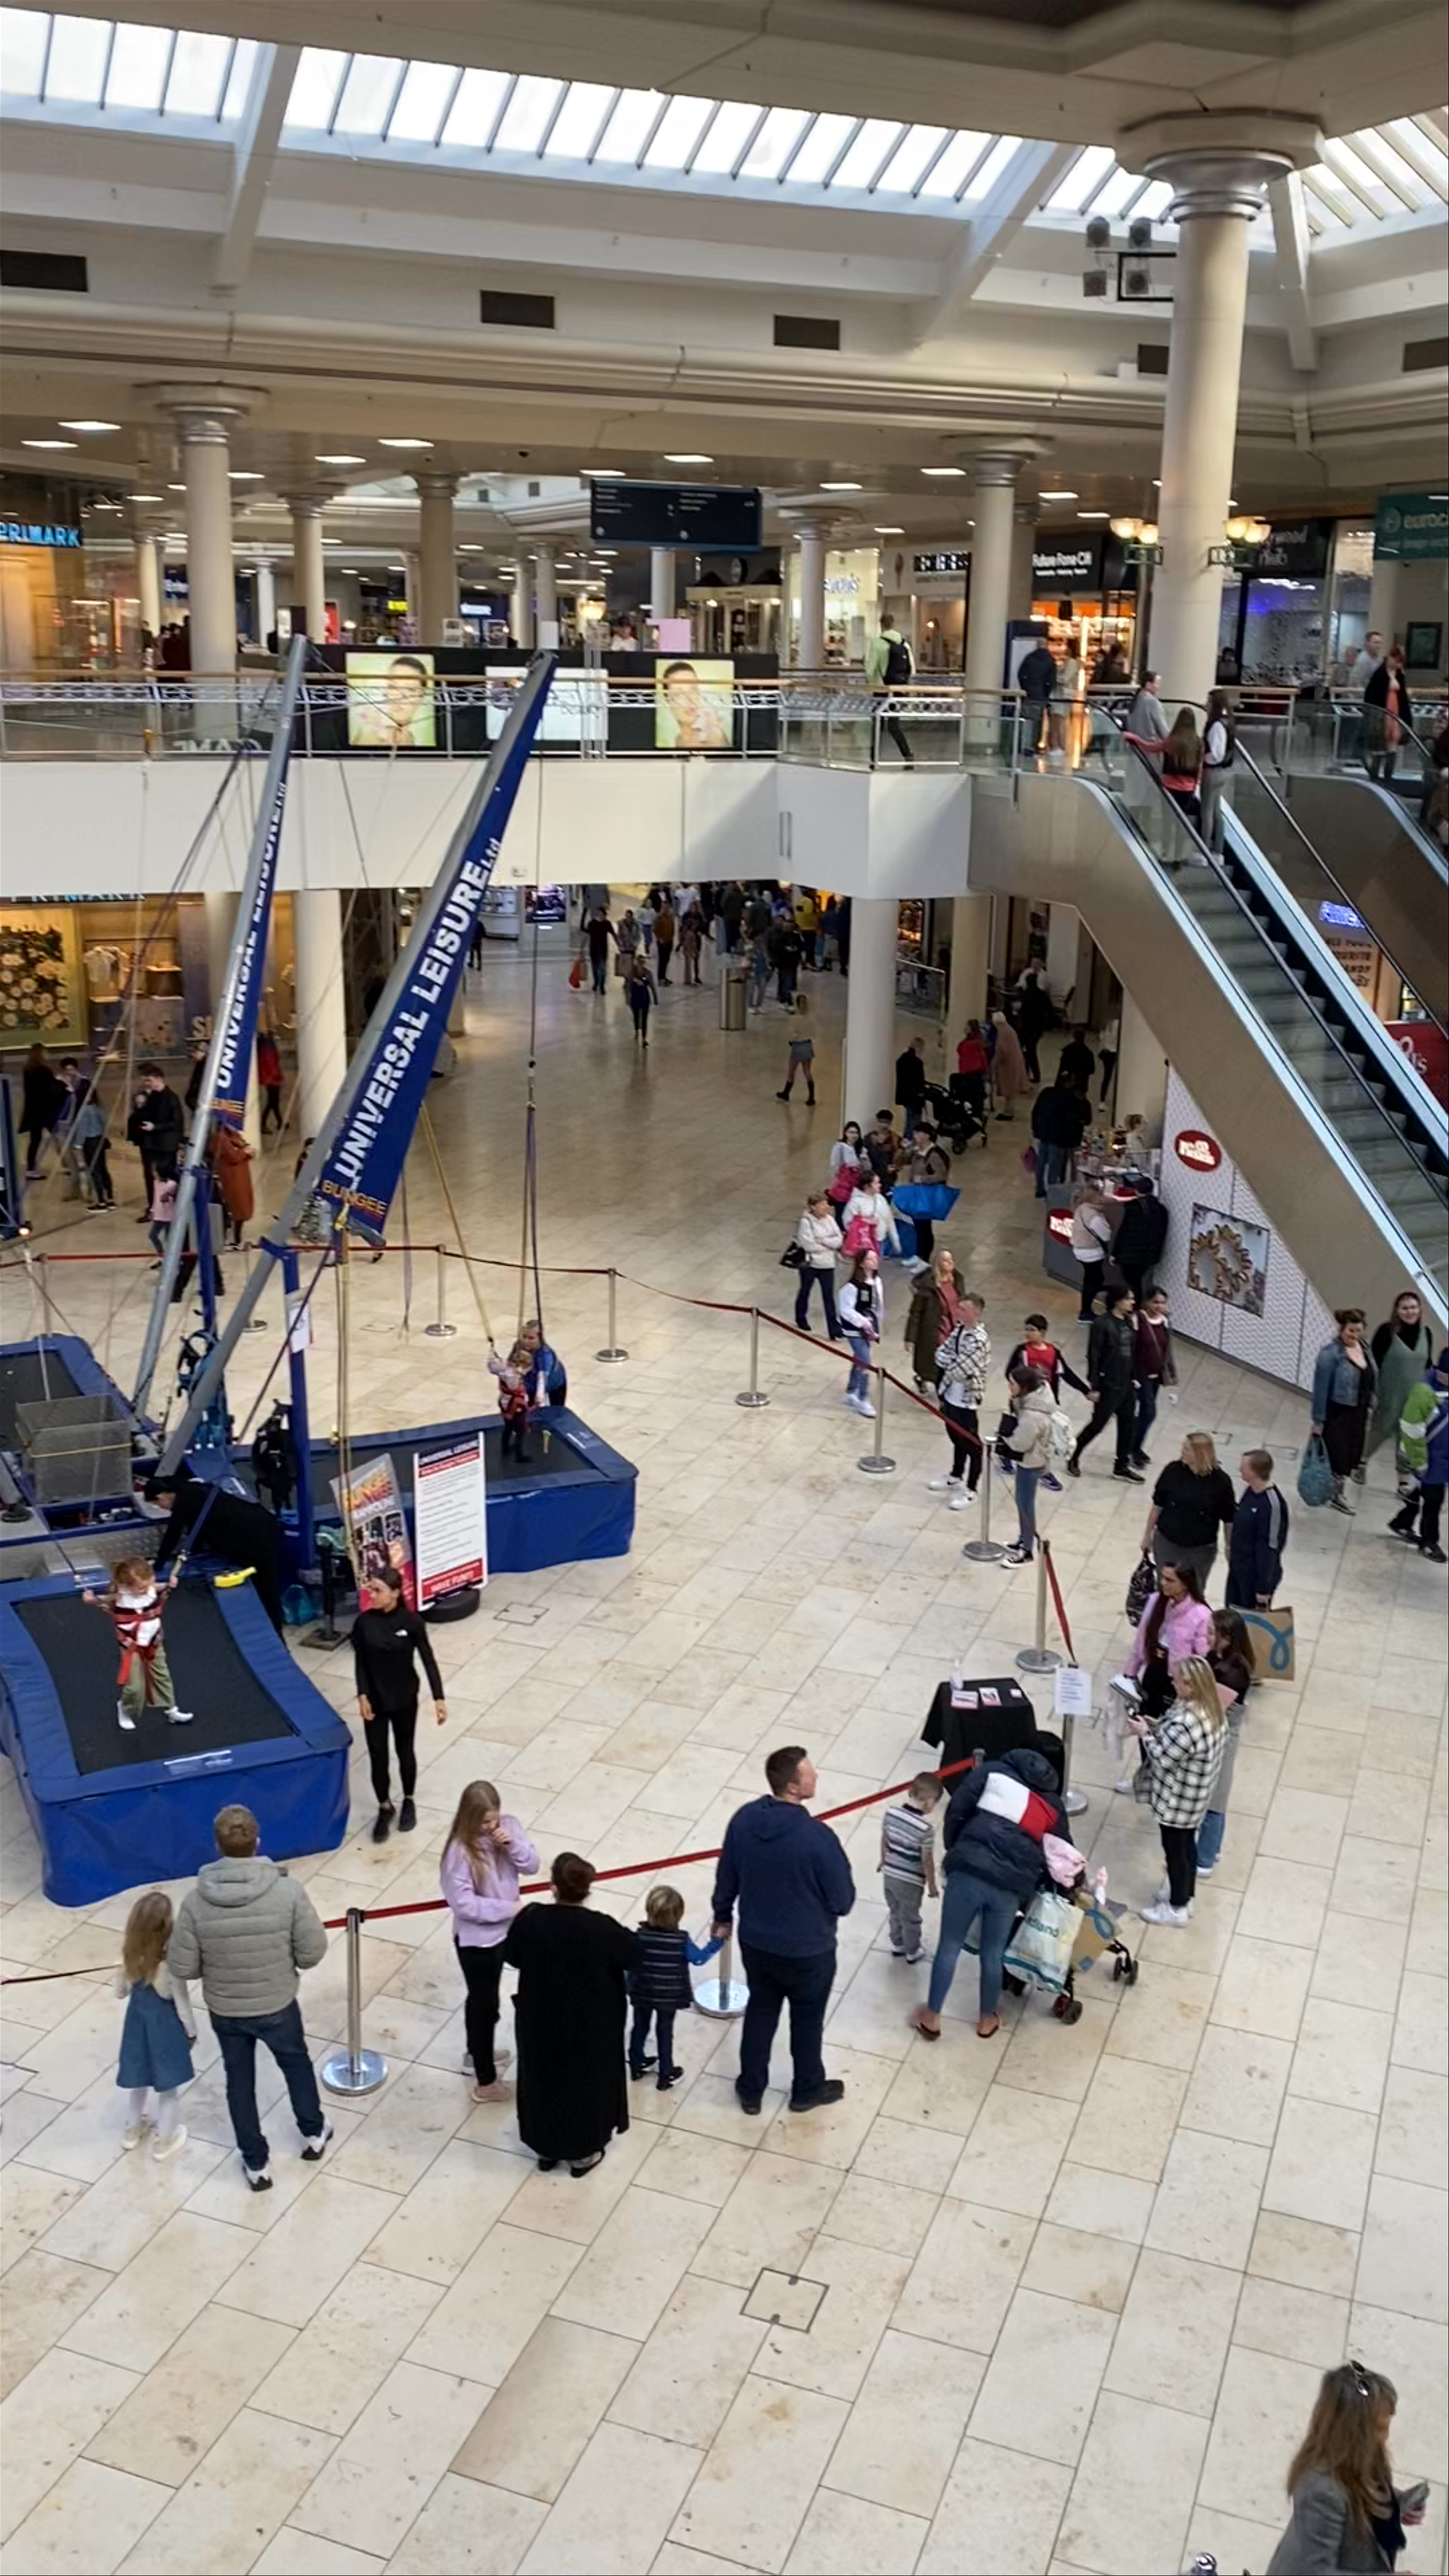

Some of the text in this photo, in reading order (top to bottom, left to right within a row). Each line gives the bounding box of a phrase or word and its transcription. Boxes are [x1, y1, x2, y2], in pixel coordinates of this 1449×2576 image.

[334, 837, 501, 1179] UNIVERSAL LEISURE Ltd
[323, 1180, 388, 1215] BUNGEE
